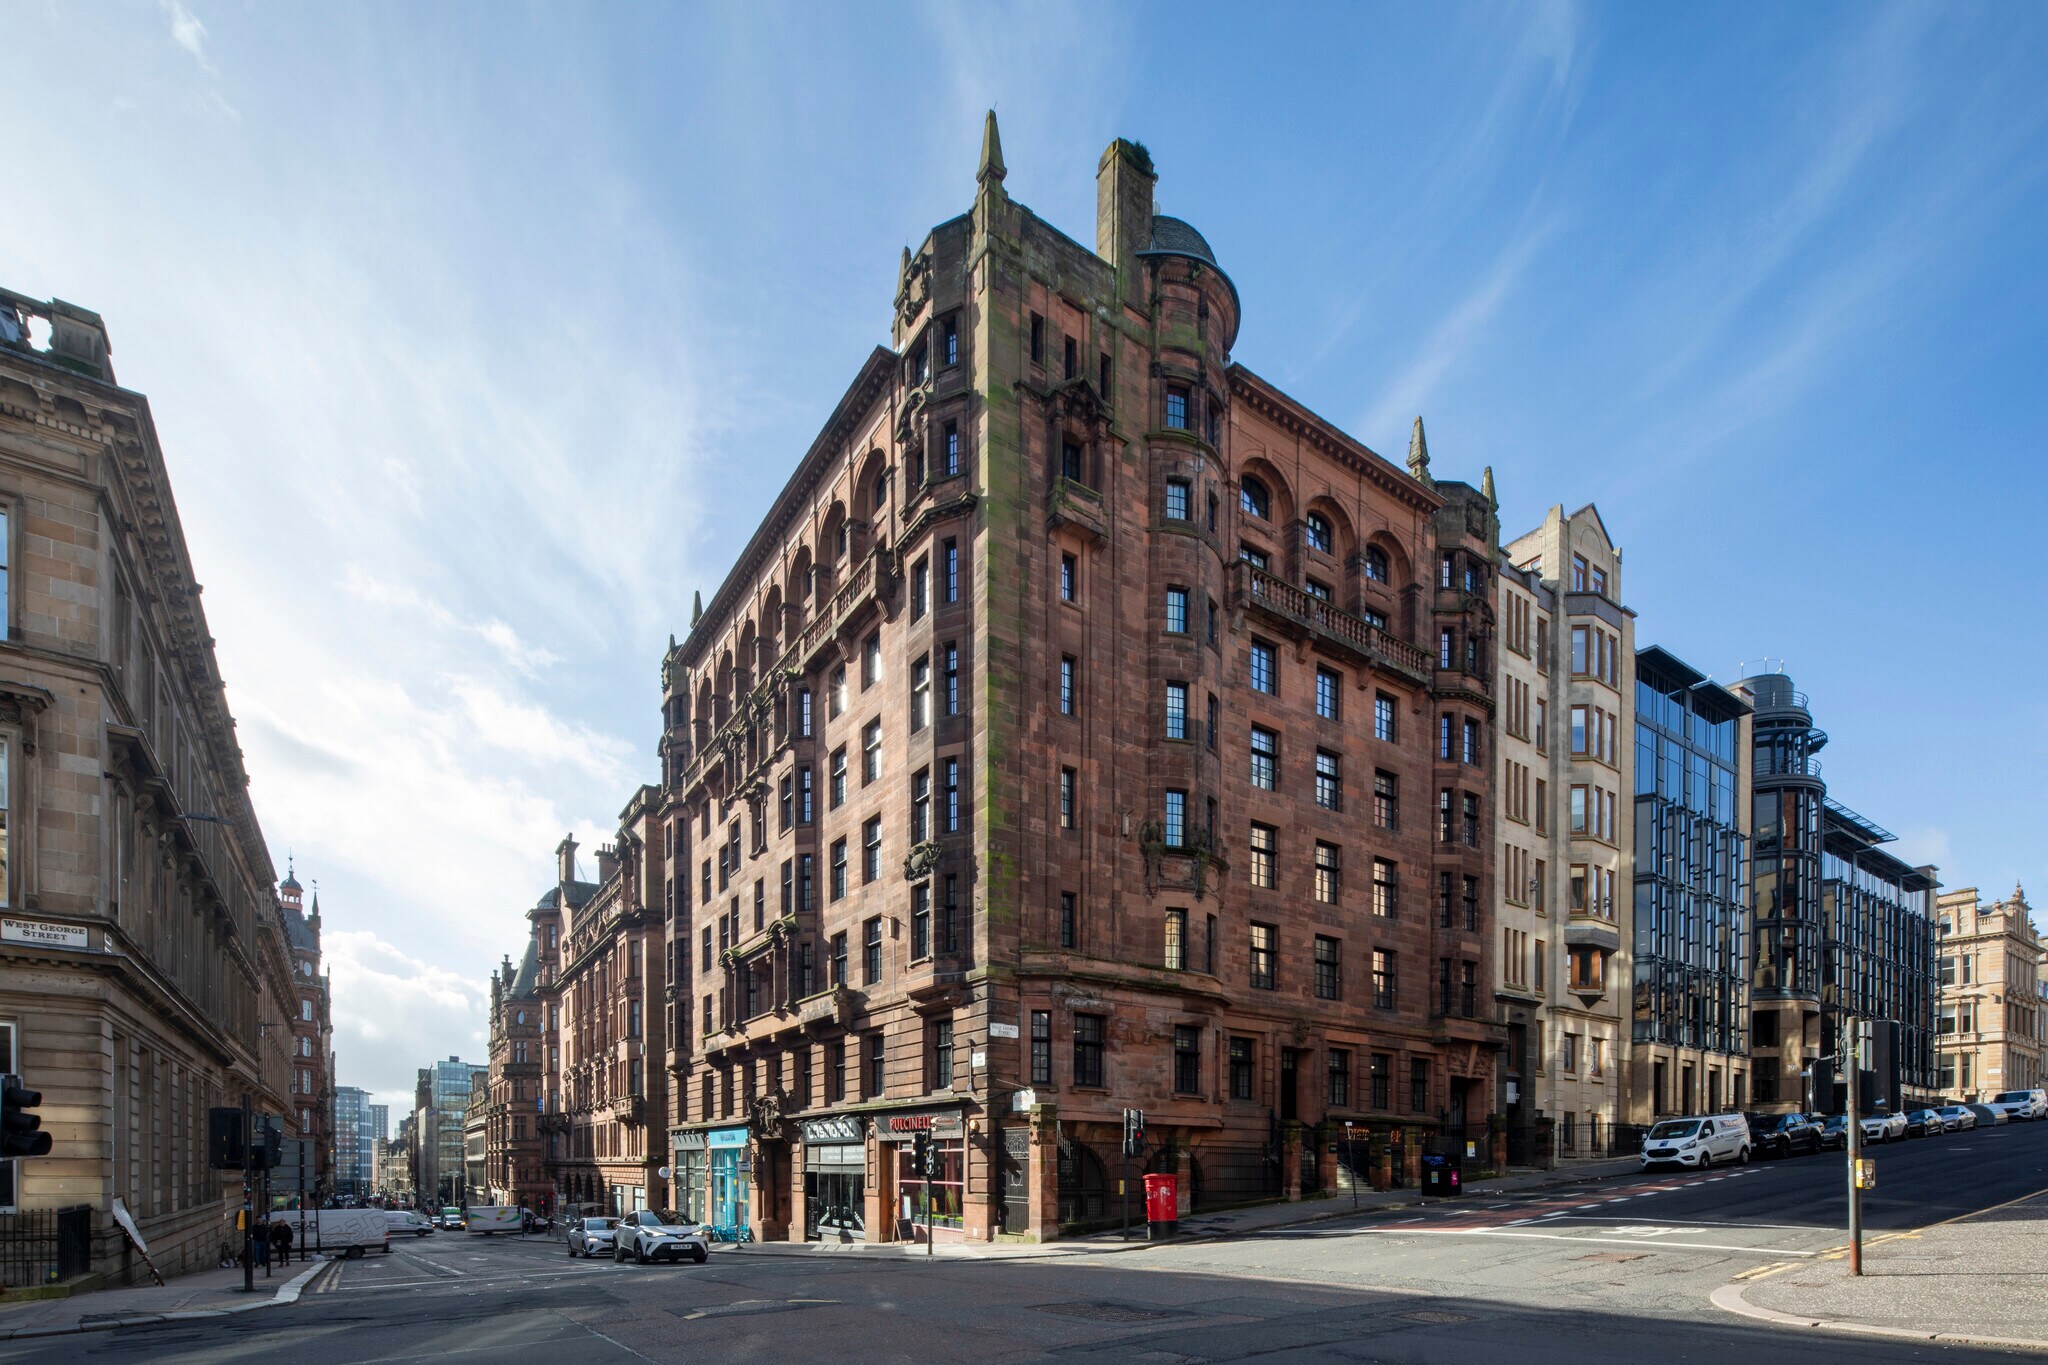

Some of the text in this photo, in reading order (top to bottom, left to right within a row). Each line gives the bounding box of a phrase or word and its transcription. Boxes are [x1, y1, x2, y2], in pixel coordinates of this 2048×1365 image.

[4, 920, 86, 935] WEST GEORGE
[22, 929, 68, 941] STREET
[889, 1115, 935, 1131] PULCINELL
